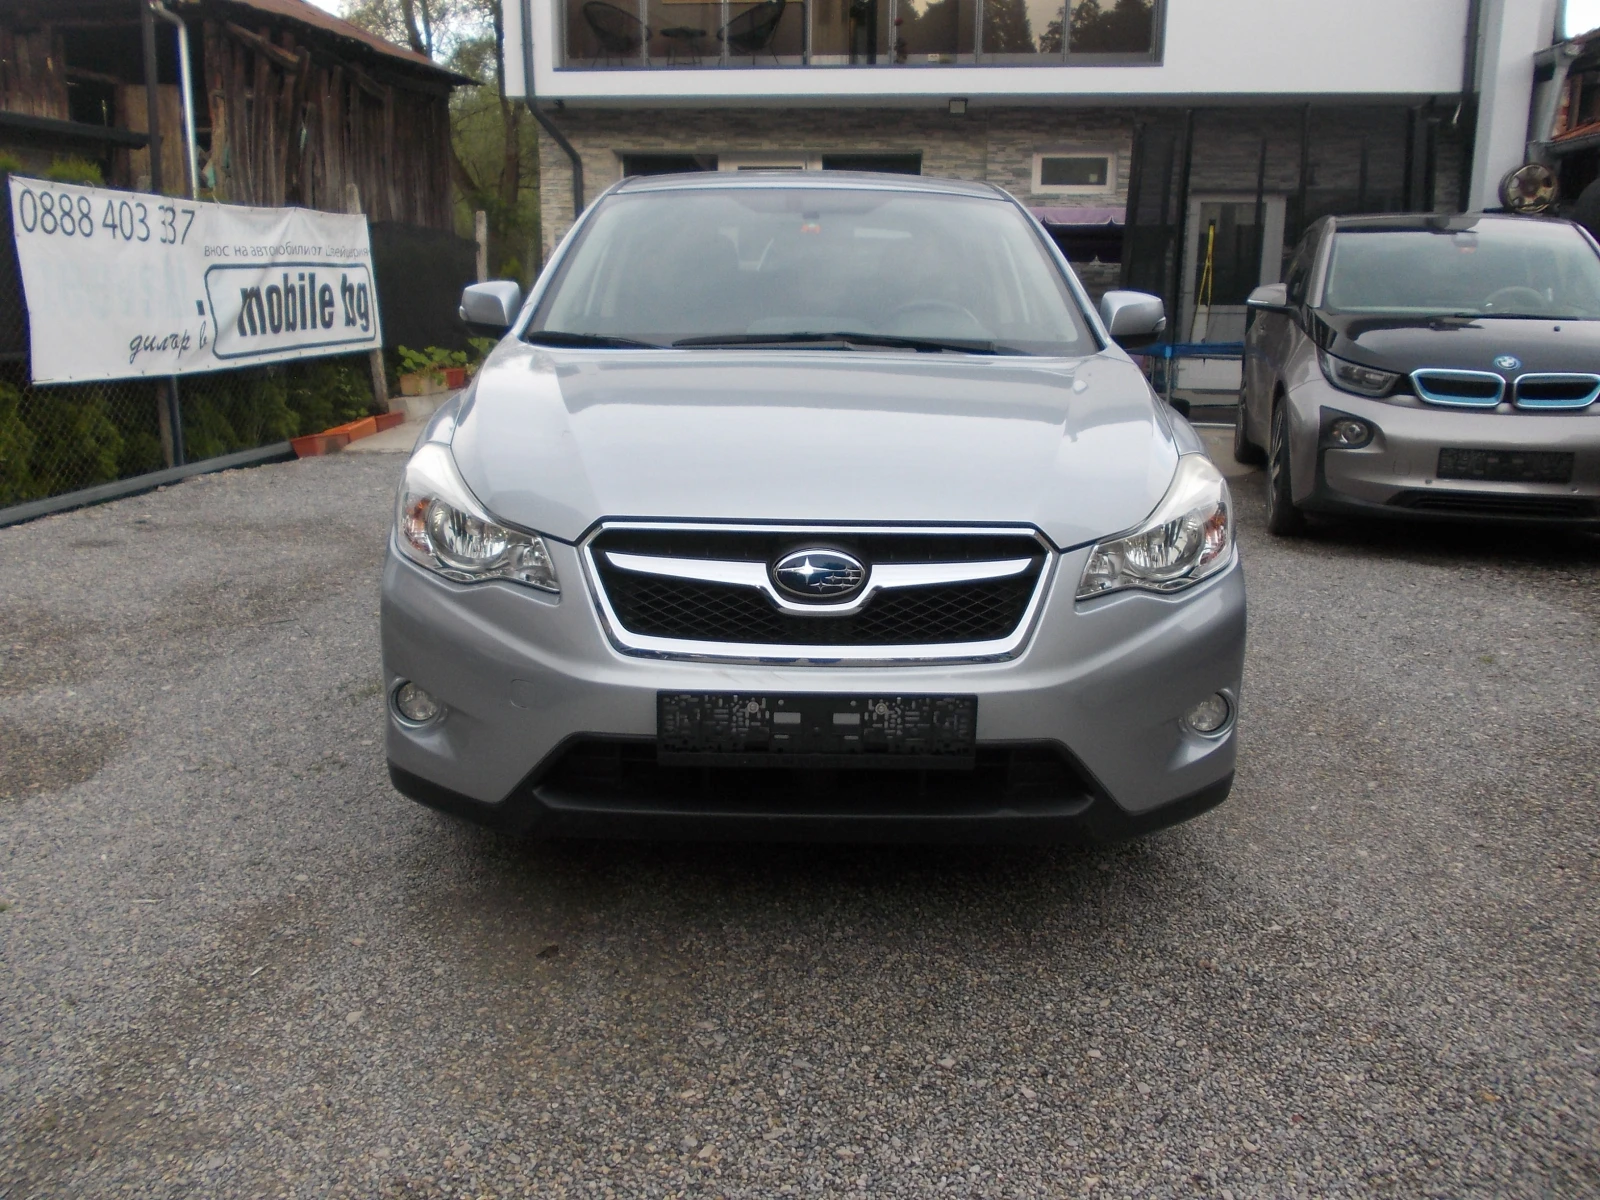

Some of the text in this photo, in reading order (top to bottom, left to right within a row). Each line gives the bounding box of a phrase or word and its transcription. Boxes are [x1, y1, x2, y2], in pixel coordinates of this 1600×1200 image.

[19, 188, 93, 238] 0888
[102, 199, 150, 242] 403
[204, 245, 229, 257] внос
[234, 245, 249, 257] на
[237, 272, 335, 337] mobile
